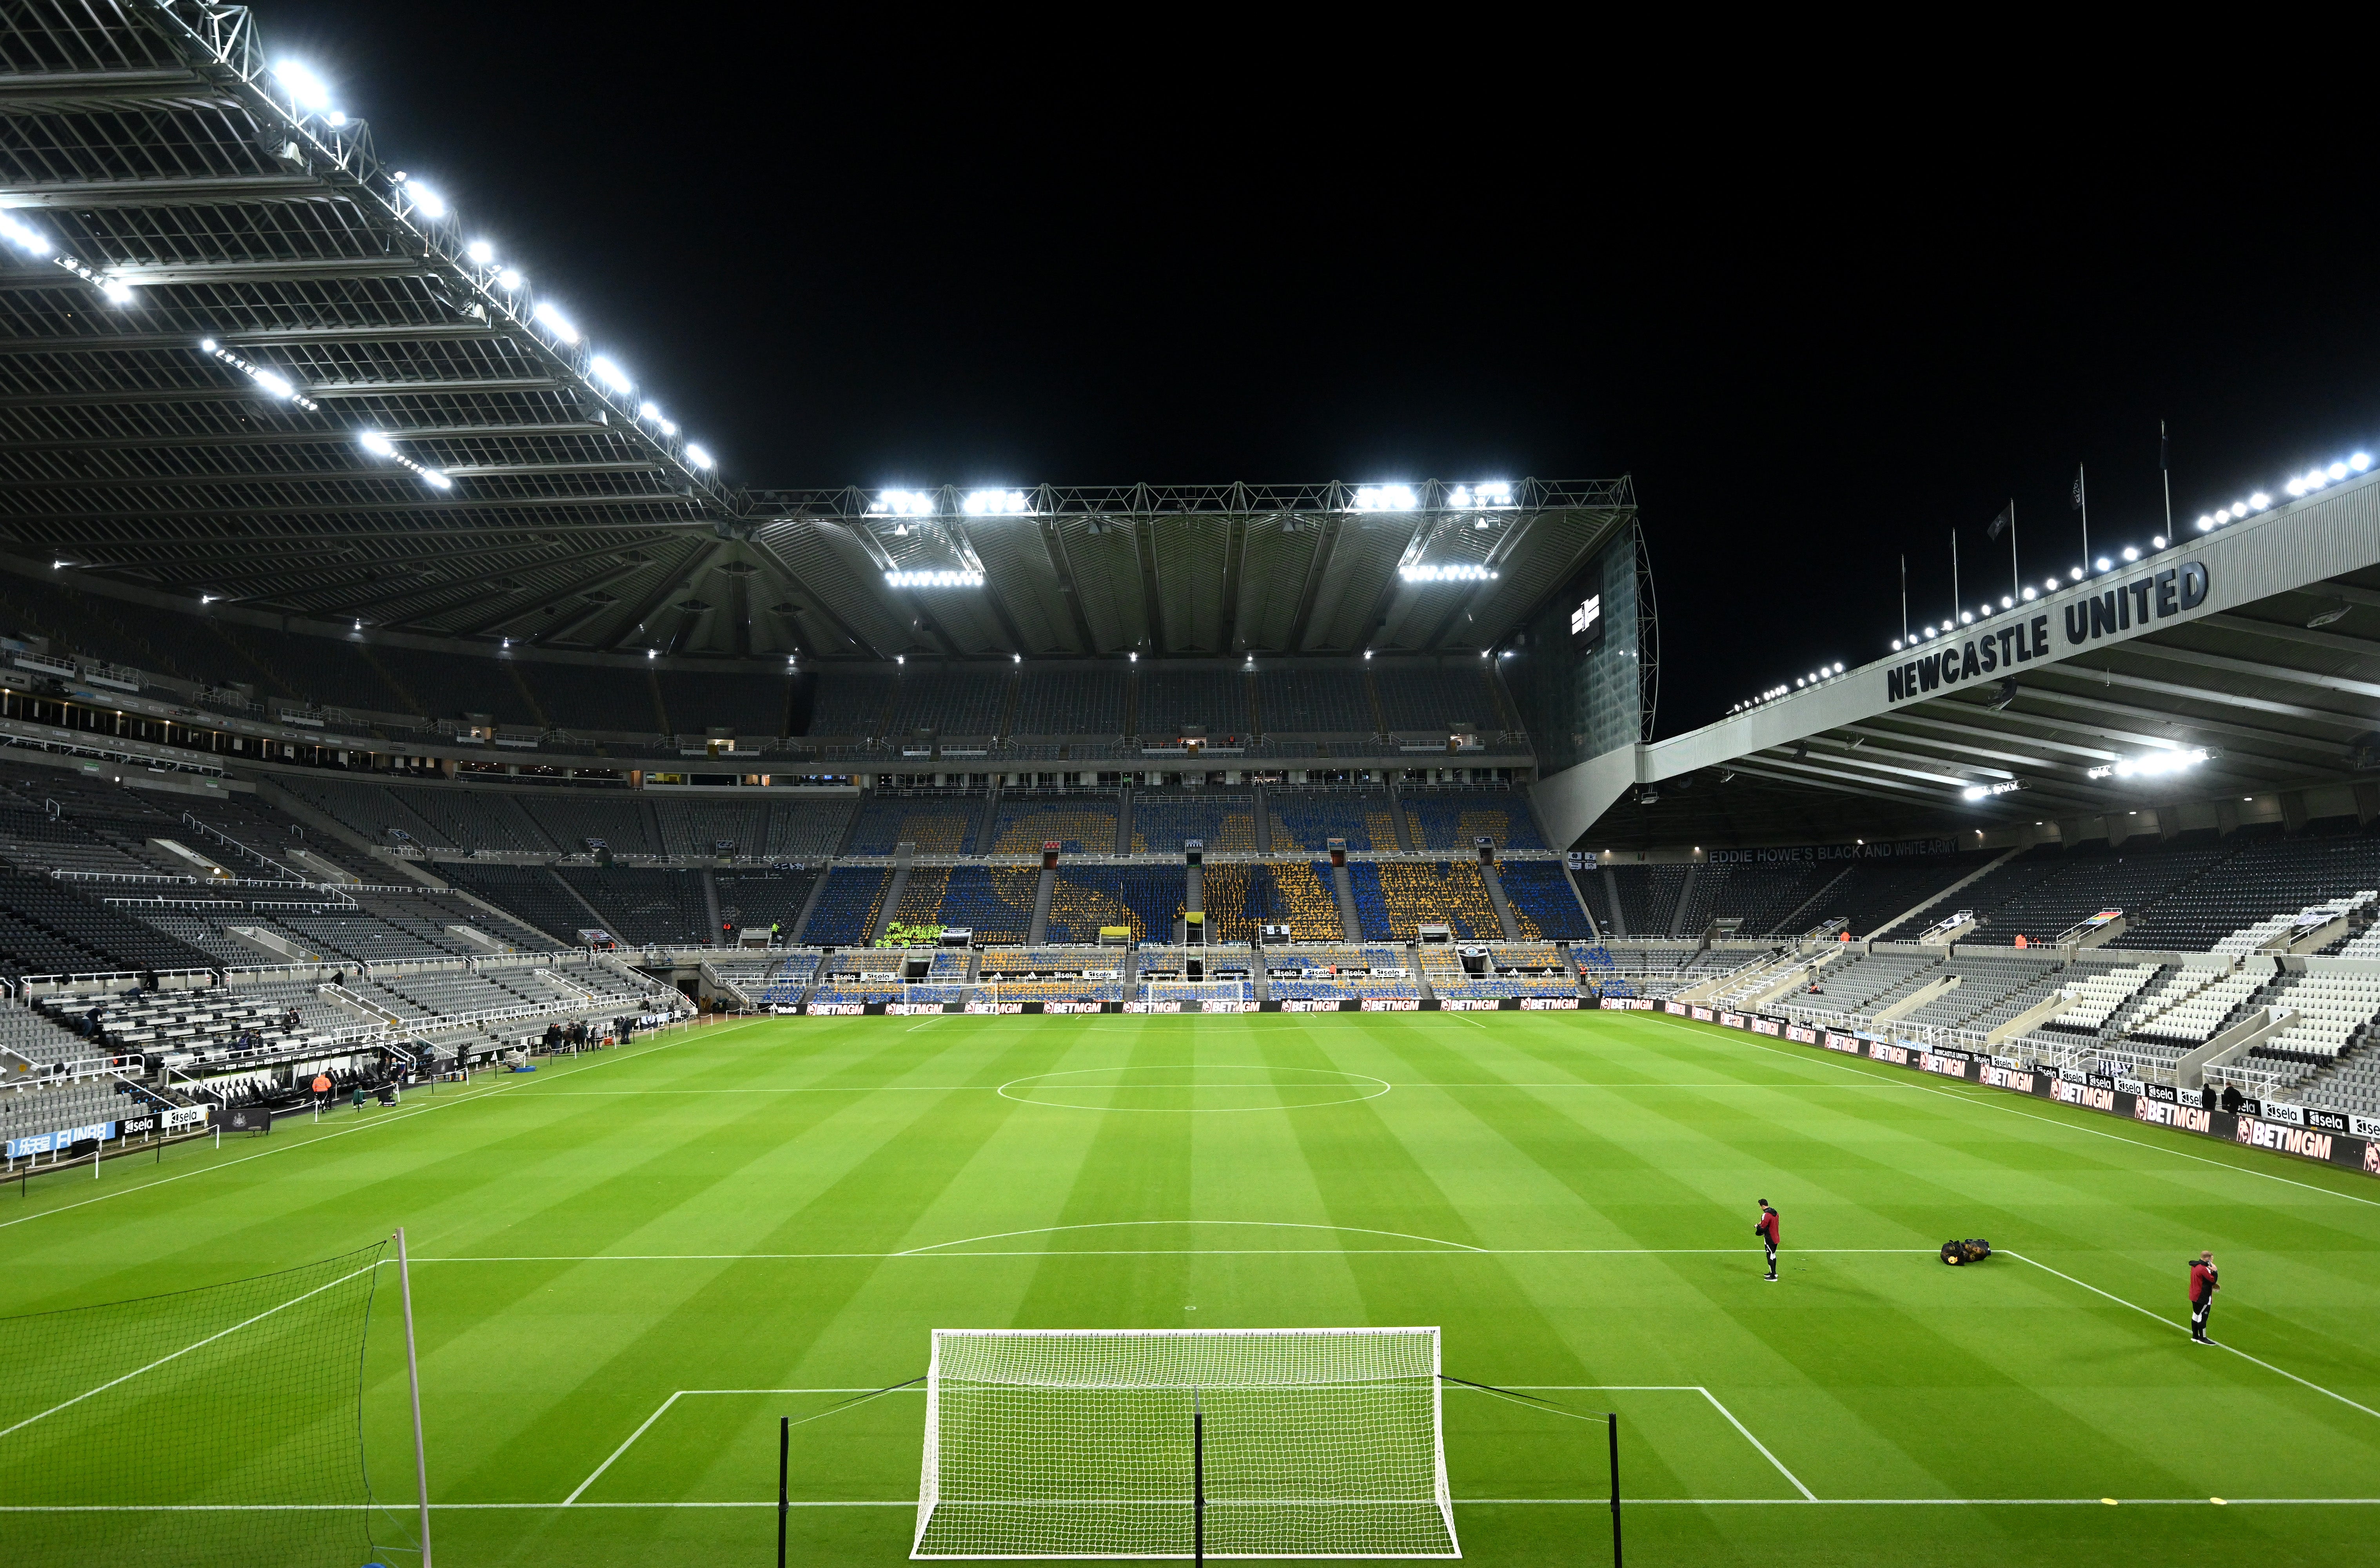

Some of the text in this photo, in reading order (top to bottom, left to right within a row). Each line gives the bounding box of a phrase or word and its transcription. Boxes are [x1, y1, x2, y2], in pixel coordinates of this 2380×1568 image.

[1888, 561, 2208, 703] NEWCASTLE UNITED
[1709, 838, 1957, 863] EDDIE HOWE'S BLACK AND WHITE ARMY
[816, 1004, 865, 1015] BETMGM
[895, 1004, 944, 1014] BETMGM
[1053, 1003, 1102, 1013] BETMGM
[1132, 1002, 1181, 1012] BETMGM
[1291, 1001, 1340, 1012] BETMGM
[1371, 1000, 1420, 1011] BETMGM
[1450, 1000, 1499, 1010] BETMGM
[1530, 999, 1579, 1010] BETMGM
[1610, 999, 1654, 1010] BETMGM
[1669, 1002, 1685, 1016] BETMGM
[1695, 1007, 1713, 1021] BETMGM
[1754, 1019, 1779, 1036] BETMGM
[1791, 1026, 1816, 1043] BETMGM
[1830, 1034, 1859, 1054] BETMGM
[1875, 1043, 1908, 1065] BETMGM
[1934, 1048, 1969, 1060] NEWCASTLE UNITED
[1978, 1056, 1990, 1065] sela
[1927, 1054, 1966, 1077] BETMGM
[2000, 1059, 2011, 1068] sela
[1988, 1067, 2033, 1092] BETMGM
[2043, 1068, 2057, 1078] sela
[2069, 1073, 2083, 1083] sela
[2096, 1077, 2111, 1089] sela
[2125, 1082, 2141, 1095] sela
[2060, 1081, 2114, 1110] BETMGM
[2156, 1088, 2173, 1101] sela
[2189, 1094, 2202, 1106] sel
[179, 1110, 197, 1122] sela
[2147, 1099, 2211, 1133] BETMGM
[2277, 1107, 2297, 1121] sela
[134, 1117, 153, 1133] sela
[2320, 1114, 2343, 1130] sela
[56, 1123, 107, 1150] FUN88
[2368, 1124, 2380, 1136] se
[18, 1135, 51, 1156] 乐天堂
[2252, 1121, 2332, 1160] BETMGM
